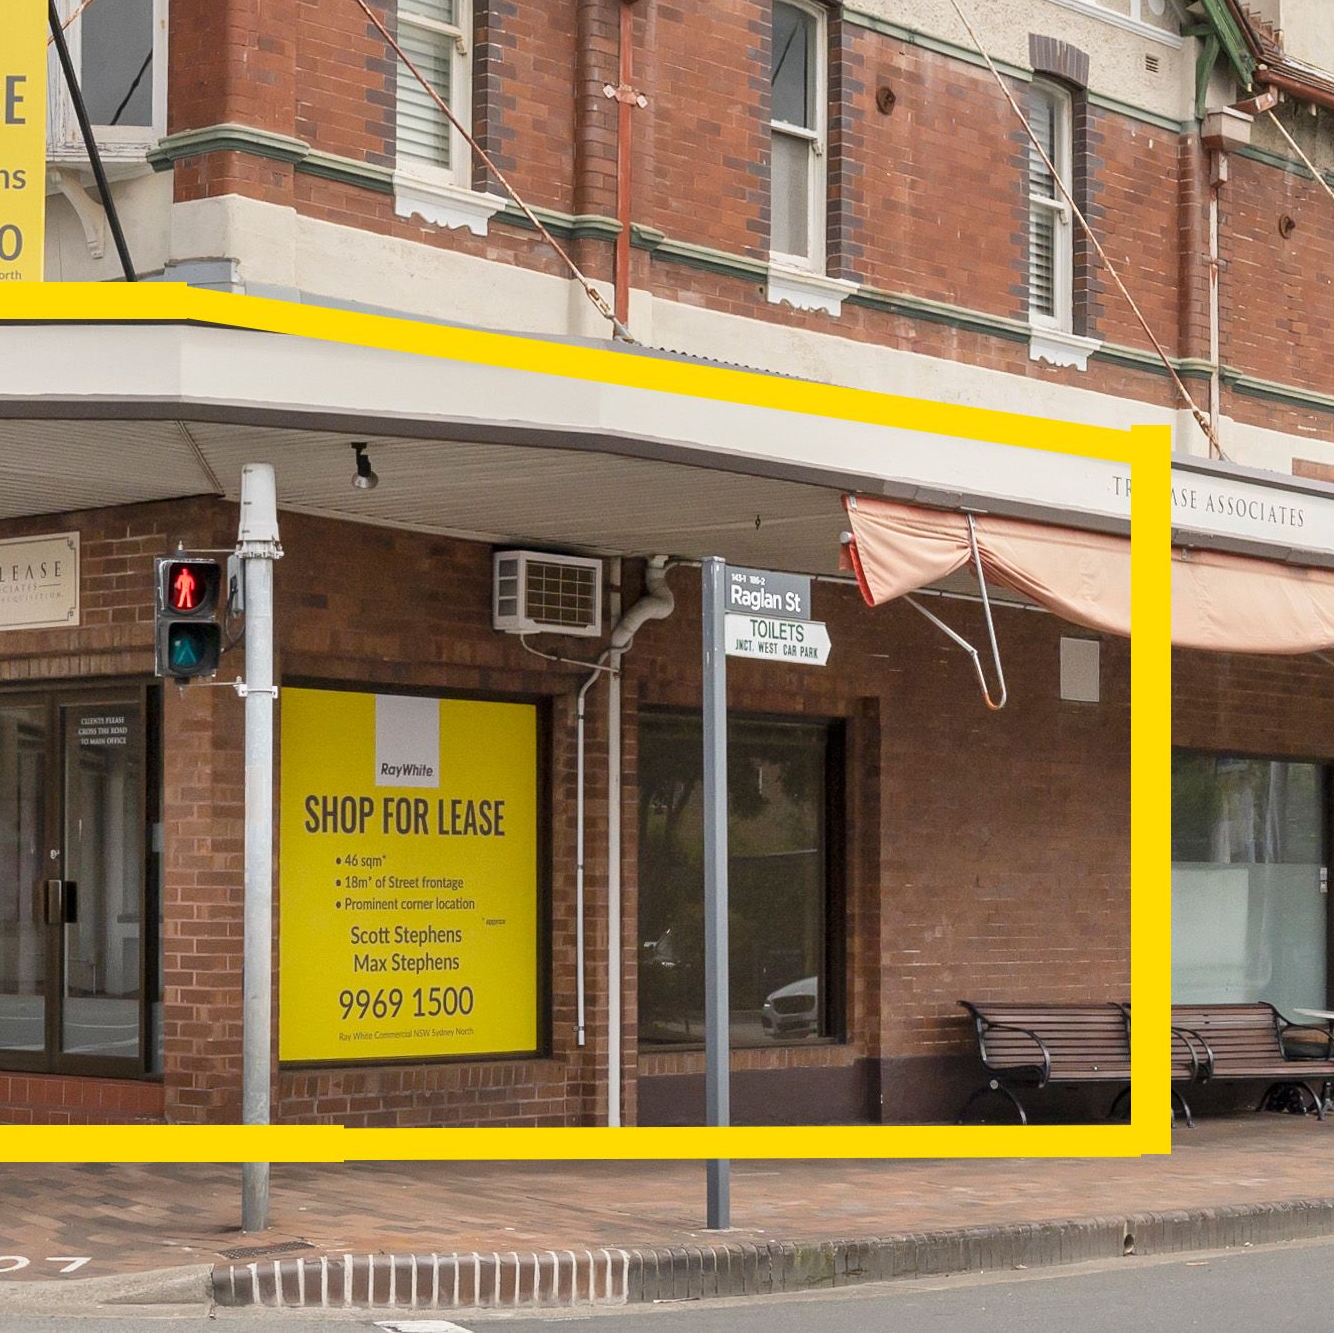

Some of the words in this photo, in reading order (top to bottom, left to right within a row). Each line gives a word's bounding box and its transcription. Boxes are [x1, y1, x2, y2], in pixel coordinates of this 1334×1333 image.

[1112, 475, 1198, 509] TRASE
[1205, 494, 1305, 528] ASSOCIATES
[731, 584, 782, 611] Raglan
[785, 591, 801, 612] St
[750, 619, 804, 642] TOILETS
[758, 641, 778, 654] WEST
[783, 644, 797, 656] CAR
[800, 647, 818, 659] PARK
[304, 794, 375, 834] SHOP
[383, 797, 430, 835] FOR
[438, 799, 506, 836] LEASE
[345, 854, 358, 866] 46
[375, 876, 387, 888] of
[389, 876, 420, 889] Street
[422, 876, 464, 891] frontage
[345, 897, 398, 910] Prominent
[401, 900, 433, 910] corner
[436, 897, 475, 910] location
[350, 926, 390, 944] Scott
[394, 925, 462, 947] Stephens
[354, 954, 388, 972] Max
[391, 952, 460, 974] Stephens
[339, 988, 403, 1020] 9969
[412, 986, 474, 1018] 1500
[339, 1032, 351, 1041] Ray
[353, 1030, 373, 1040] White
[374, 1029, 413, 1039] Commercial
[413, 1029, 430, 1038] NSW
[432, 1028, 454, 1038] Sydney
[455, 1027, 474, 1036] North
